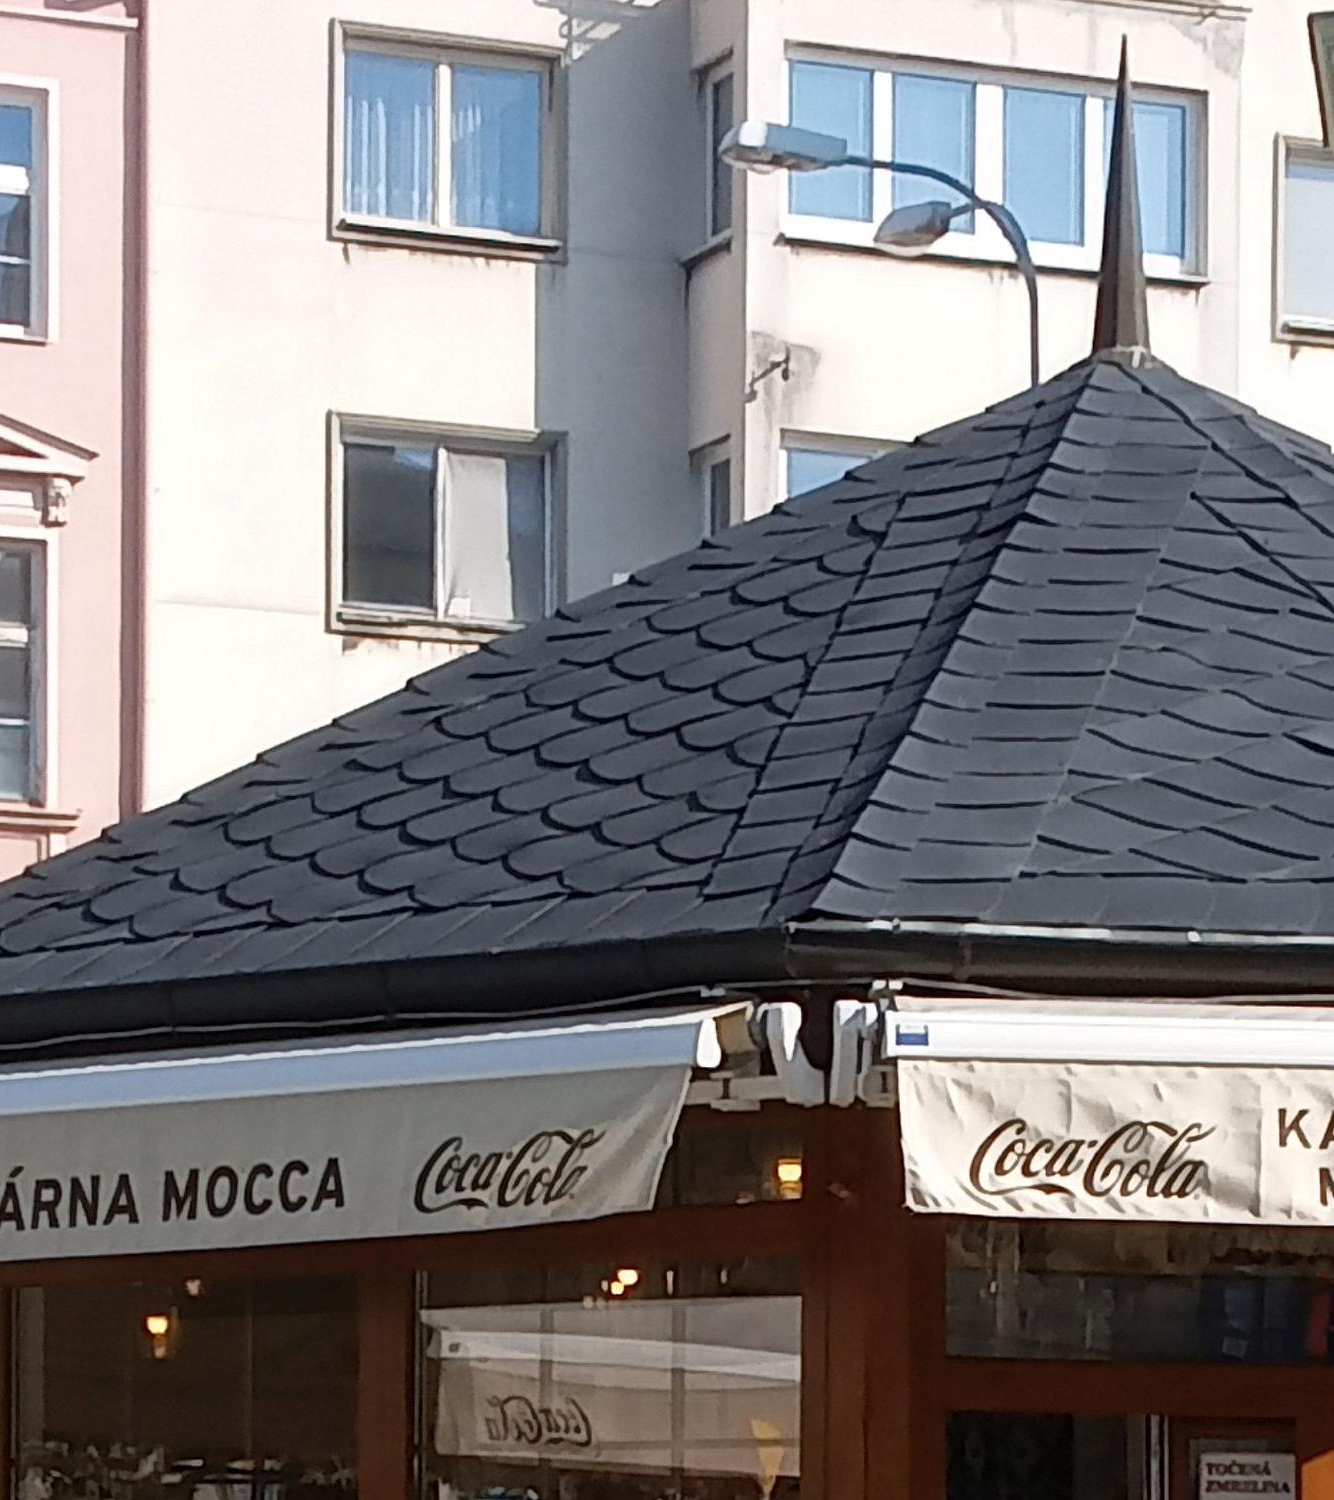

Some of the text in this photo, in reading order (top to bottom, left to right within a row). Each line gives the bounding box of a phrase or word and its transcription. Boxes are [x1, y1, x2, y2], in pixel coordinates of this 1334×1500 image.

[161, 1157, 346, 1223] MOCCA
[414, 1128, 605, 1215] Coca-Cola
[969, 1117, 1217, 1199] Coca-Cola
